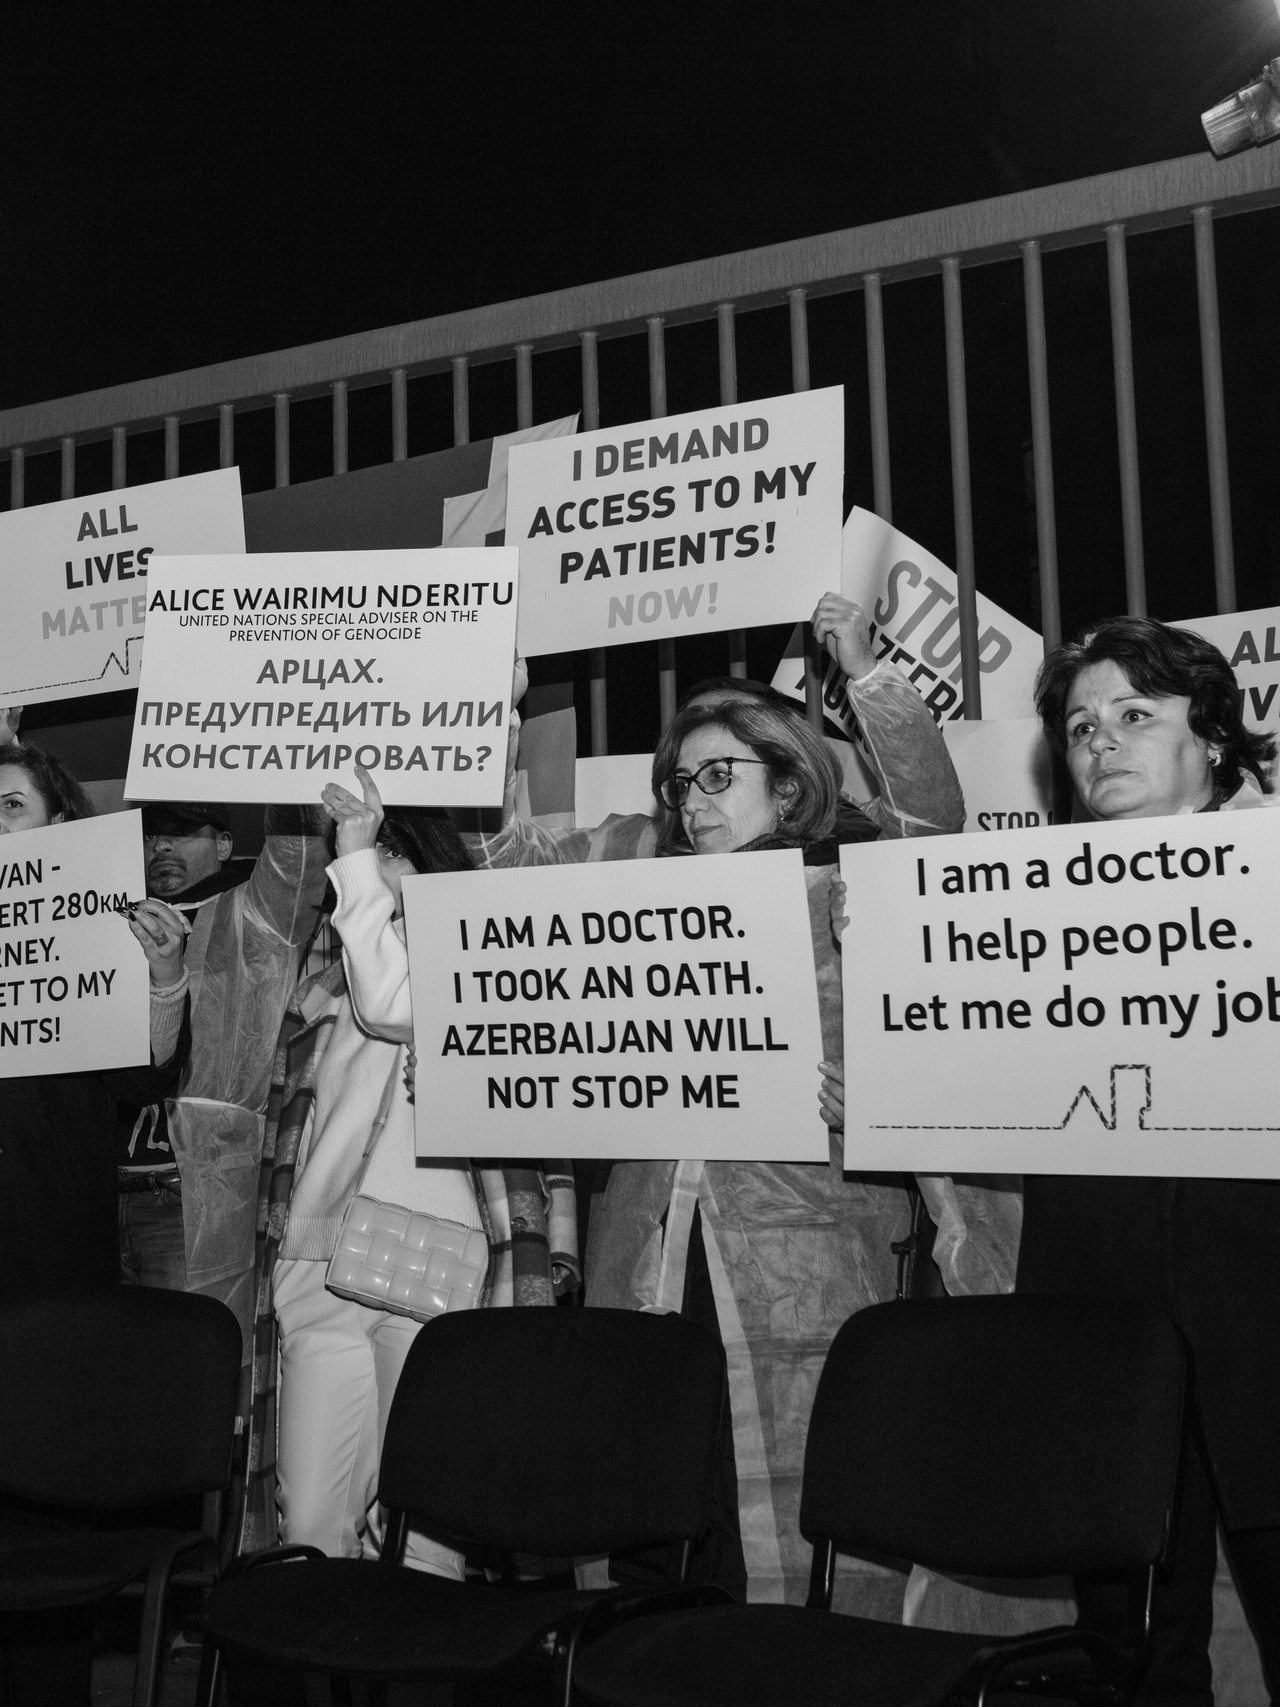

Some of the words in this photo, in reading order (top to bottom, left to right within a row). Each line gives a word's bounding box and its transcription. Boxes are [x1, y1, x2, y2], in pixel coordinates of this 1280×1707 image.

[573, 449, 582, 482] I
[595, 417, 769, 478] DEMAND
[527, 485, 676, 539] ACCESS
[687, 475, 740, 513] TO
[753, 461, 817, 504] MY
[76, 504, 139, 542] ALL
[65, 546, 155, 590] LIVES
[559, 521, 776, 585] PATIENTS!
[41, 594, 147, 640] MATTE
[148, 588, 225, 612] ALICE
[233, 585, 367, 611] WAIRIMU
[376, 581, 513, 608] NDERITU
[179, 614, 230, 628] UNITED
[233, 613, 297, 626] NATIONS
[300, 612, 355, 626] SPECIAL
[357, 610, 418, 625] ADVISER
[422, 610, 447, 624] ON
[450, 609, 478, 623] THE
[607, 581, 719, 629] NOW!
[229, 628, 318, 642] PREVENTION
[321, 628, 341, 642] OF
[344, 626, 422, 641] GENOCIDE
[874, 560, 1013, 686] STOP
[1229, 626, 1280, 668] AL
[256, 658, 384, 691] АРЦАХ.
[140, 701, 411, 734] ПРЕДУПРЕДИТЬ
[422, 700, 504, 728] ИЛИ
[142, 743, 492, 772] КОНСТАТИРОВАТЬ?
[917, 857, 926, 896] I
[941, 861, 1010, 895] am
[1025, 859, 1050, 889] a
[1065, 841, 1250, 886] doctor.
[459, 919, 469, 951] I
[481, 915, 535, 950] AM
[546, 913, 572, 947] A
[581, 904, 746, 945] DOCTOR.
[922, 924, 932, 964] I
[947, 917, 1047, 973] help
[1062, 906, 1253, 971] people.
[29, 975, 69, 1004] TO
[77, 968, 117, 999] MY
[453, 972, 462, 1004] I
[472, 967, 571, 1003] TOOK
[581, 965, 634, 1000] AN
[646, 960, 764, 998] OATH.
[882, 993, 950, 1032] Let
[961, 999, 1032, 1030] me
[1046, 984, 1106, 1028] do
[1121, 993, 1200, 1039] my
[441, 1019, 673, 1057] AZERBAIJAN
[684, 1016, 789, 1052] WILL
[487, 1076, 560, 1109] NOT
[571, 1075, 669, 1109] STOP
[681, 1074, 740, 1109] ME
